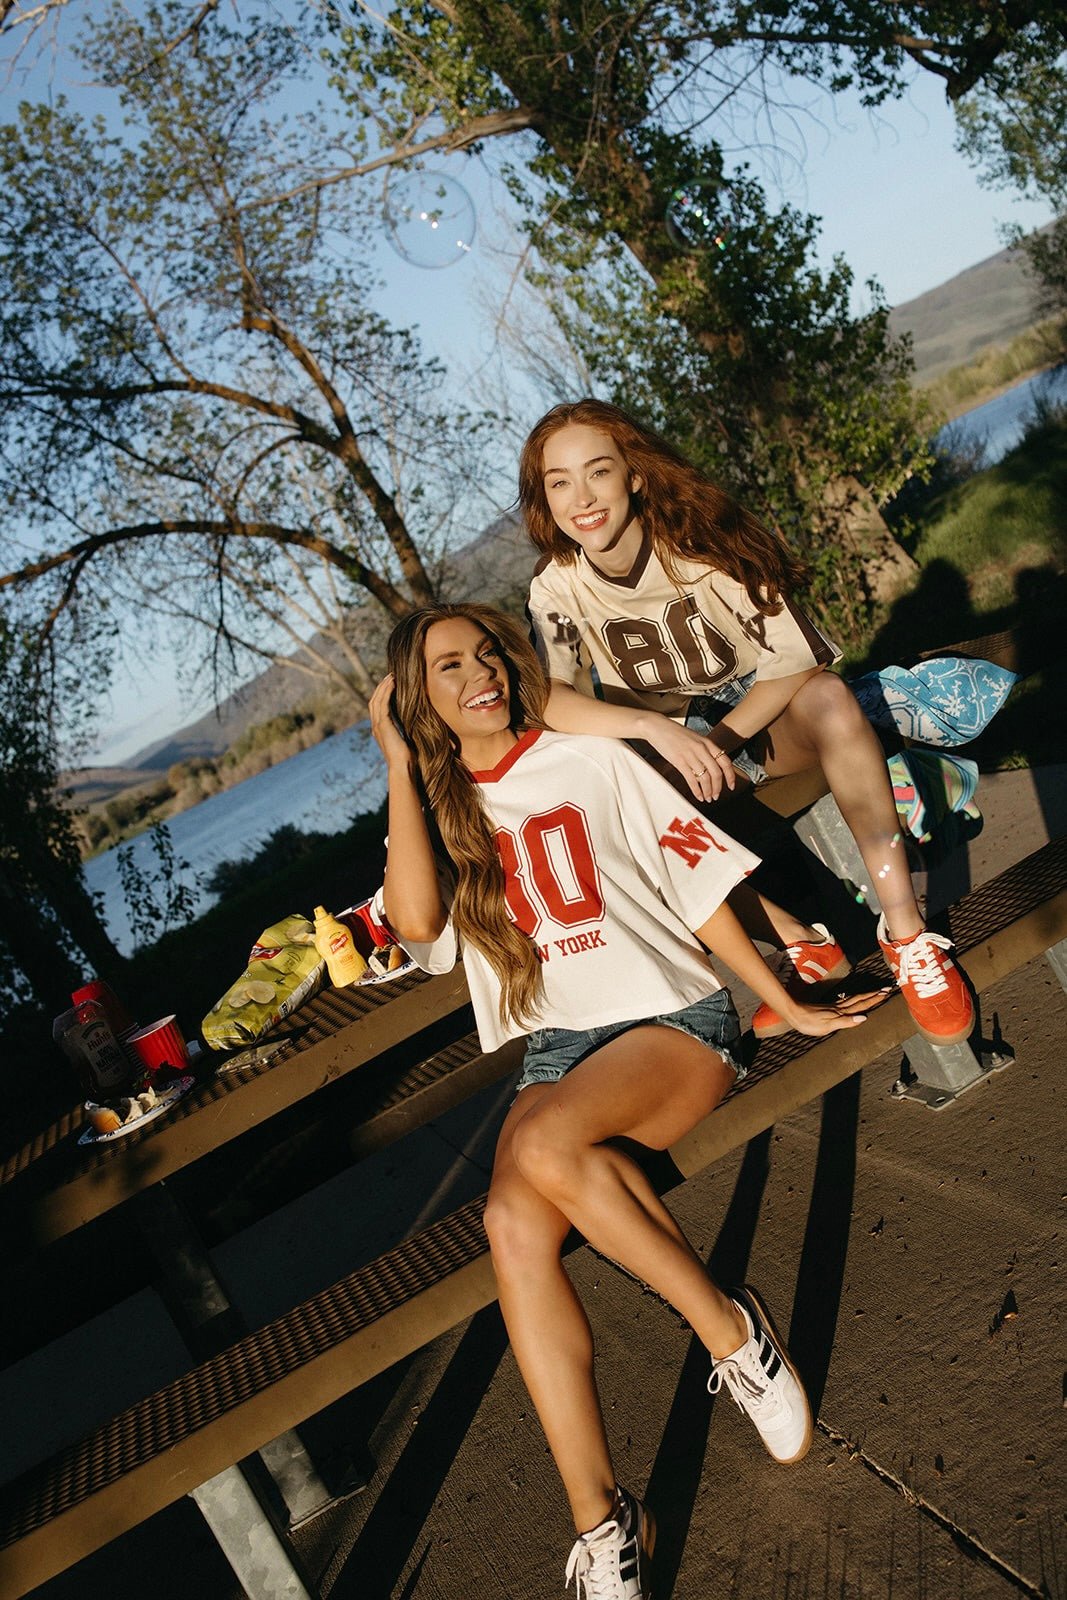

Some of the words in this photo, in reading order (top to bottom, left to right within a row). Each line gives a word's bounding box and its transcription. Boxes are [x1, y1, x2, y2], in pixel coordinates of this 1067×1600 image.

[601, 592, 739, 692] 80
[659, 816, 728, 870] NY
[553, 929, 607, 957] YORK
